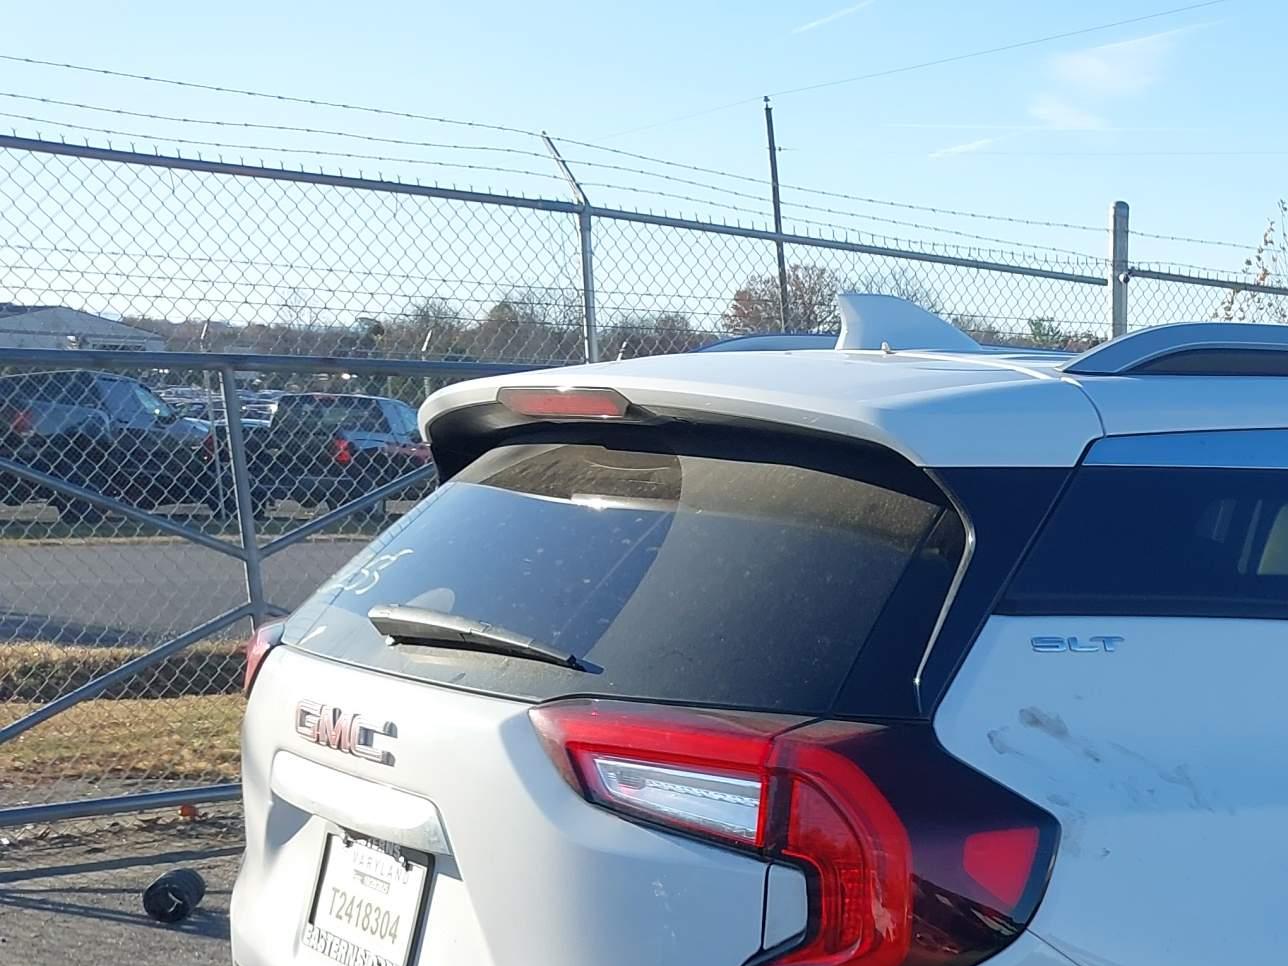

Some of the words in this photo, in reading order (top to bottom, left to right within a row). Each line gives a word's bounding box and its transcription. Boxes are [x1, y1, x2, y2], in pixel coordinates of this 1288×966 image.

[1030, 635, 1125, 653] SLT
[295, 699, 399, 767] GMC
[327, 886, 402, 945] T2418304
